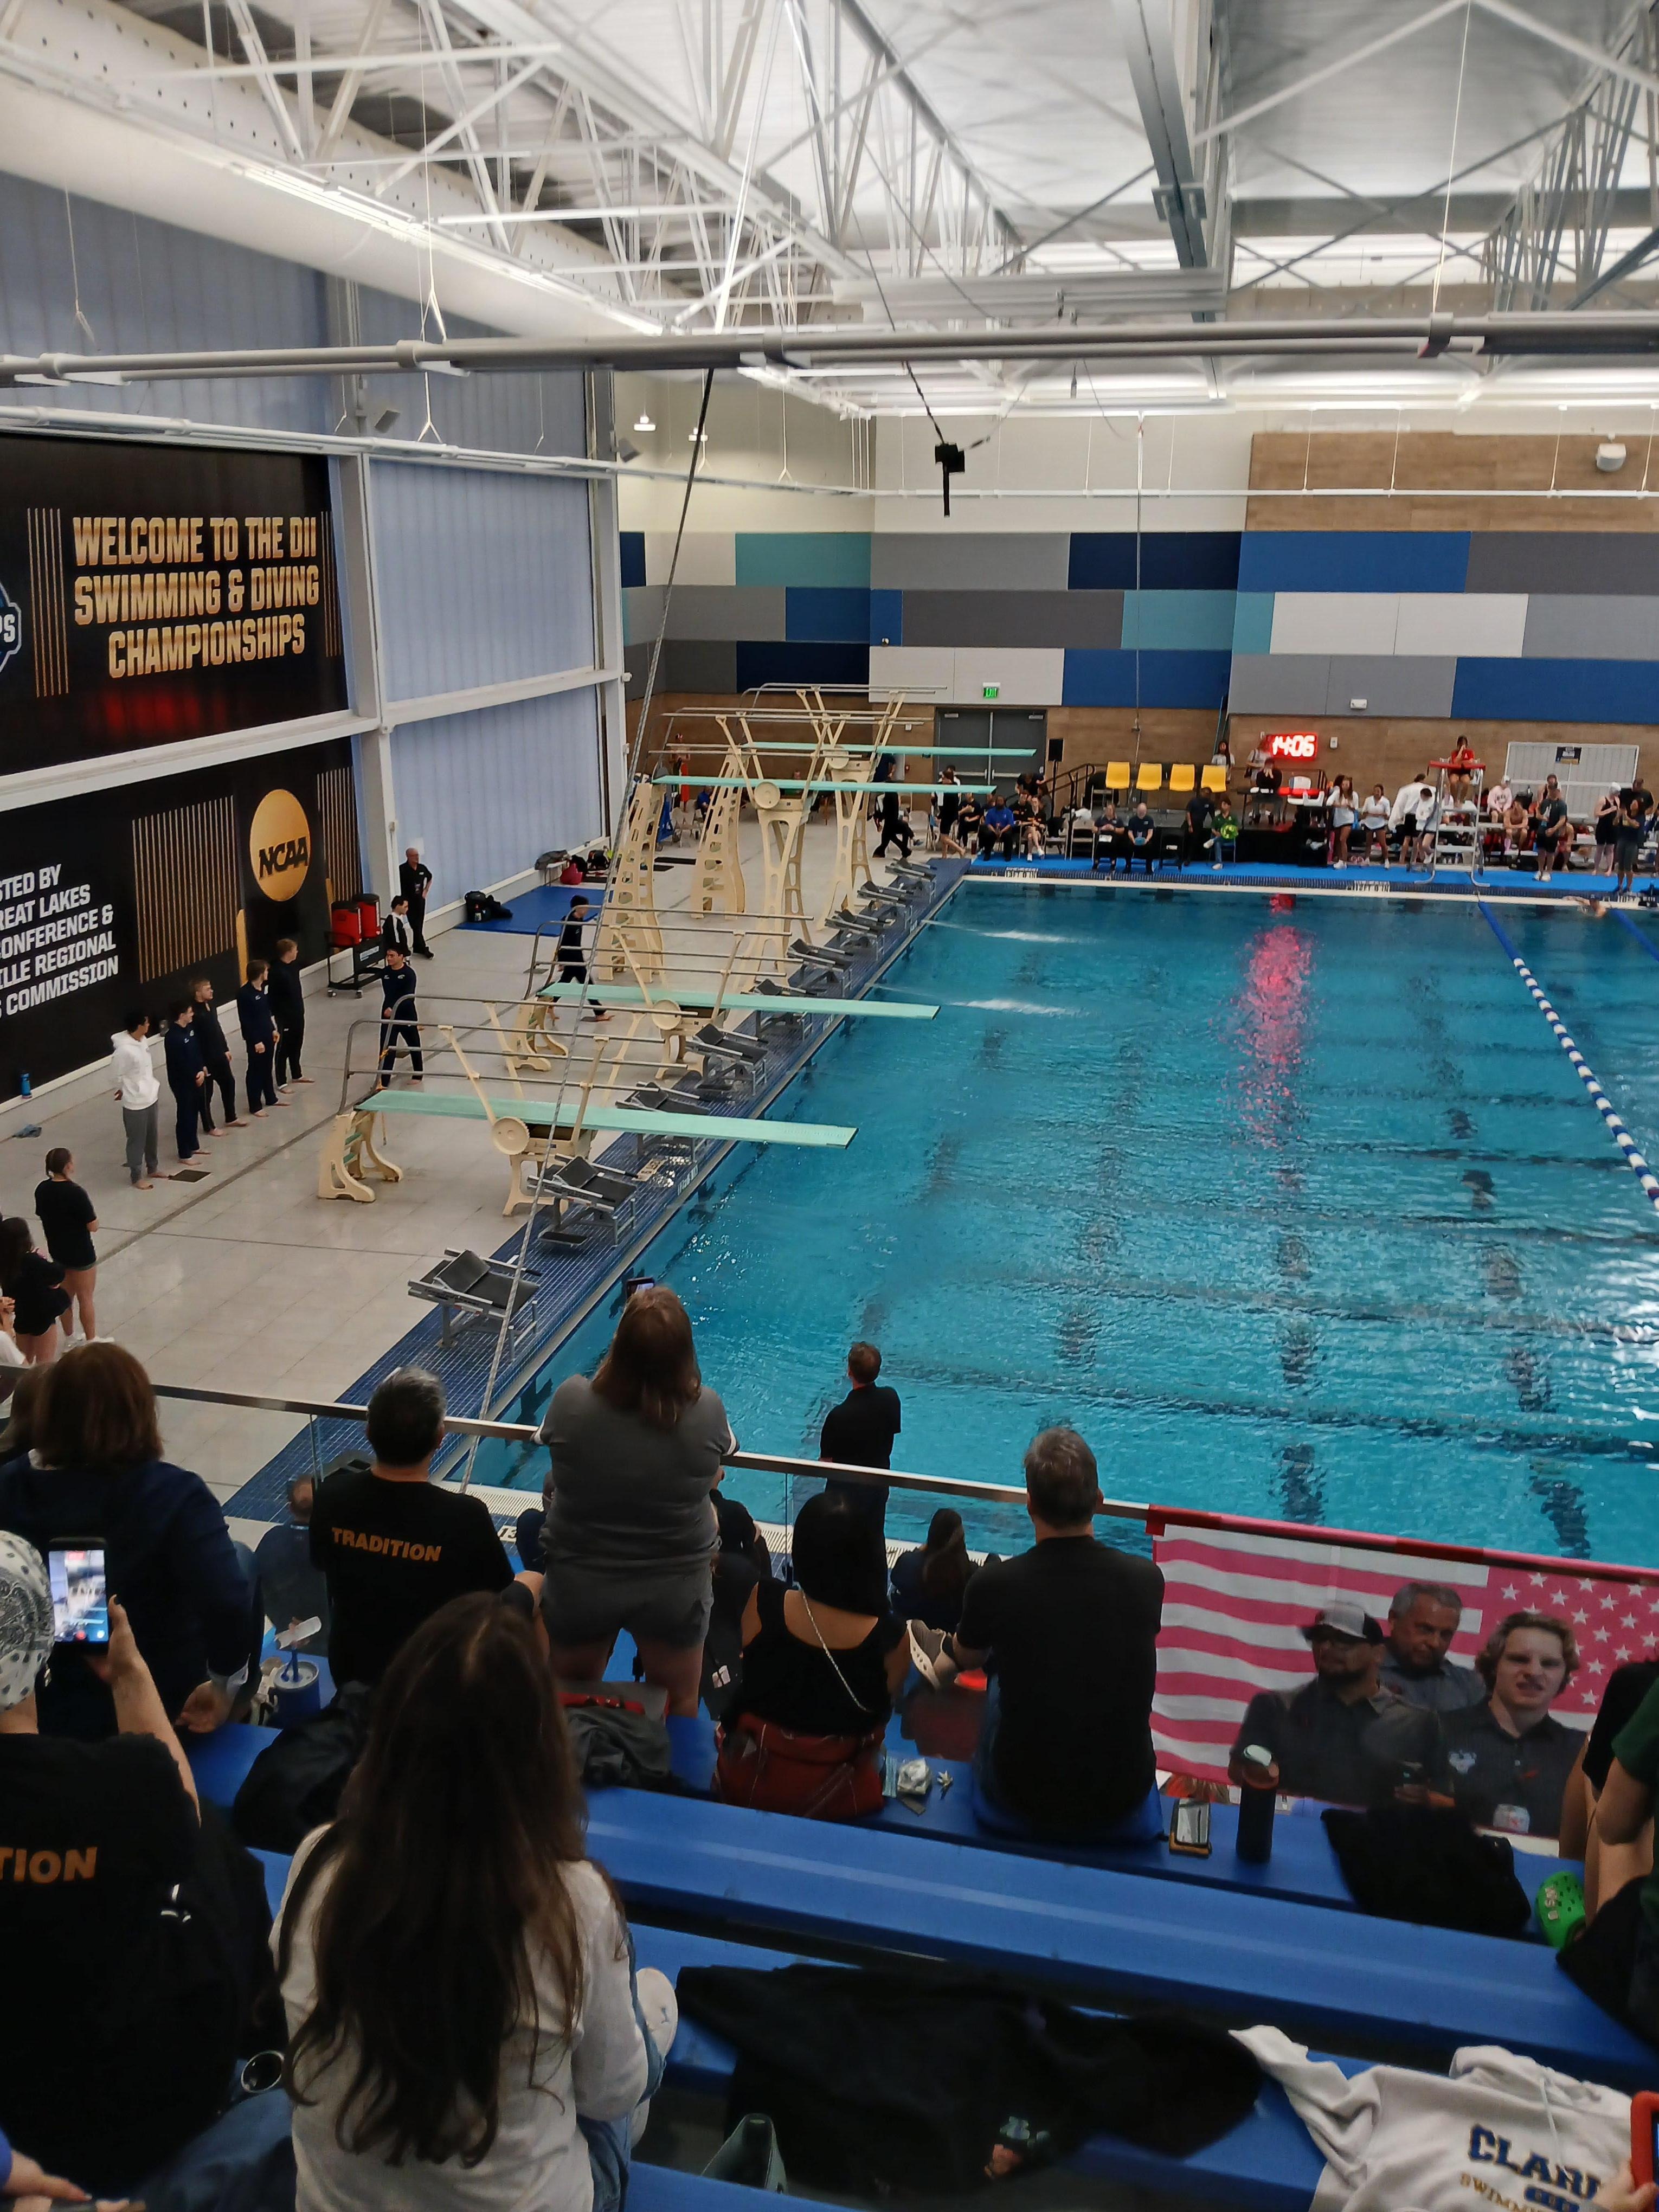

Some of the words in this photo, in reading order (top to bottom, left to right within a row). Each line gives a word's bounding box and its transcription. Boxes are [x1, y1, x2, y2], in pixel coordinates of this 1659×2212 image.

[73, 517, 203, 566] WELCOME
[210, 517, 238, 561] TO
[245, 517, 284, 560] THE
[290, 517, 316, 558] DII
[74, 570, 221, 626] SWIMMING
[228, 569, 245, 612] &
[250, 565, 319, 611] DIVING
[108, 613, 305, 679] CHAMPIONSHIPS
[1272, 735, 1315, 757] 14:06
[259, 837, 308, 878] NCAA
[0, 871, 35, 902] TED
[39, 864, 61, 890] BY
[40, 884, 91, 918] LAKES
[0, 909, 98, 959] ONFERENCE
[102, 904, 113, 925] &
[35, 930, 117, 976] REGIONAL
[6, 955, 119, 1015] COMMISSION
[331, 1527, 442, 1562] TRADITION
